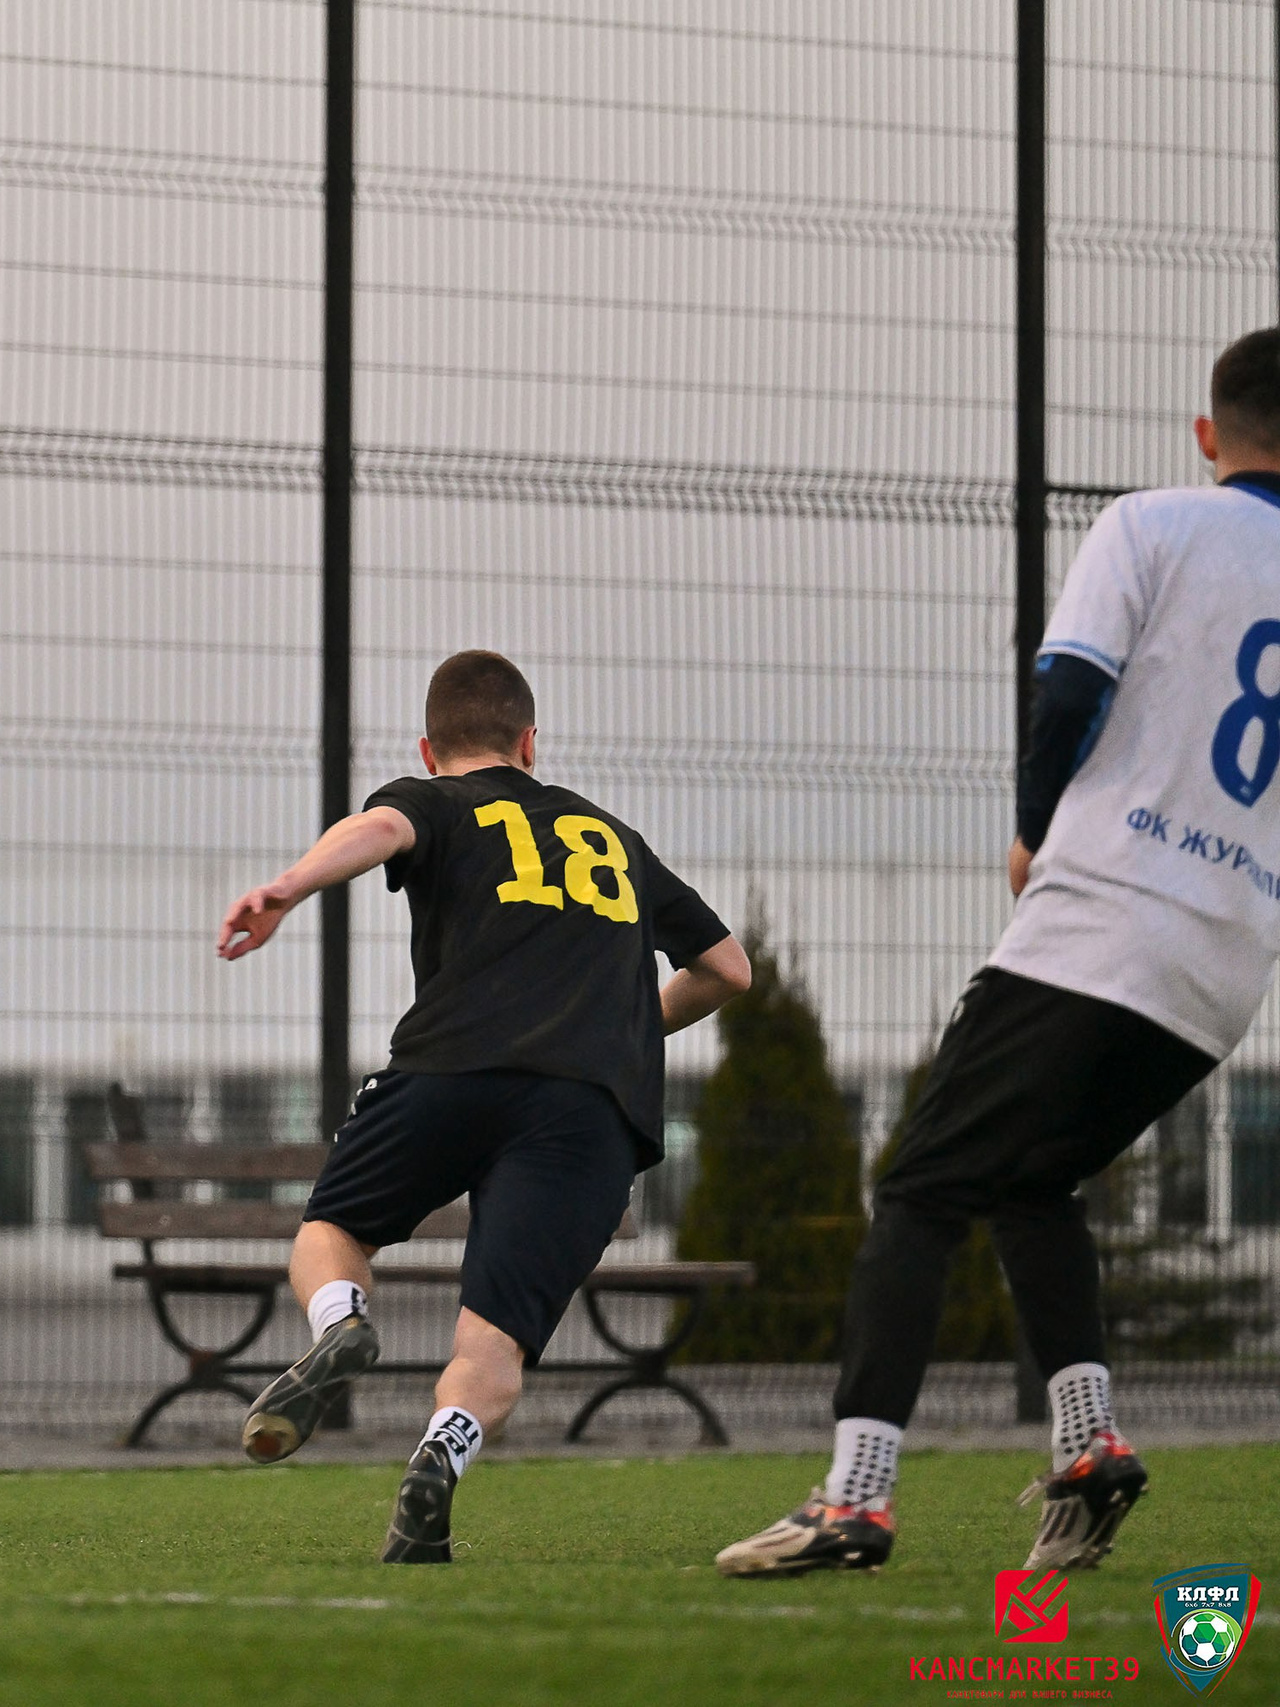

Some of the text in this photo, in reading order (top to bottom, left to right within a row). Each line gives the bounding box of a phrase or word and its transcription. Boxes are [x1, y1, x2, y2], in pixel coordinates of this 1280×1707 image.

[1211, 619, 1280, 808] 8
[474, 800, 639, 924] 18
[1127, 808, 1172, 843] ФК
